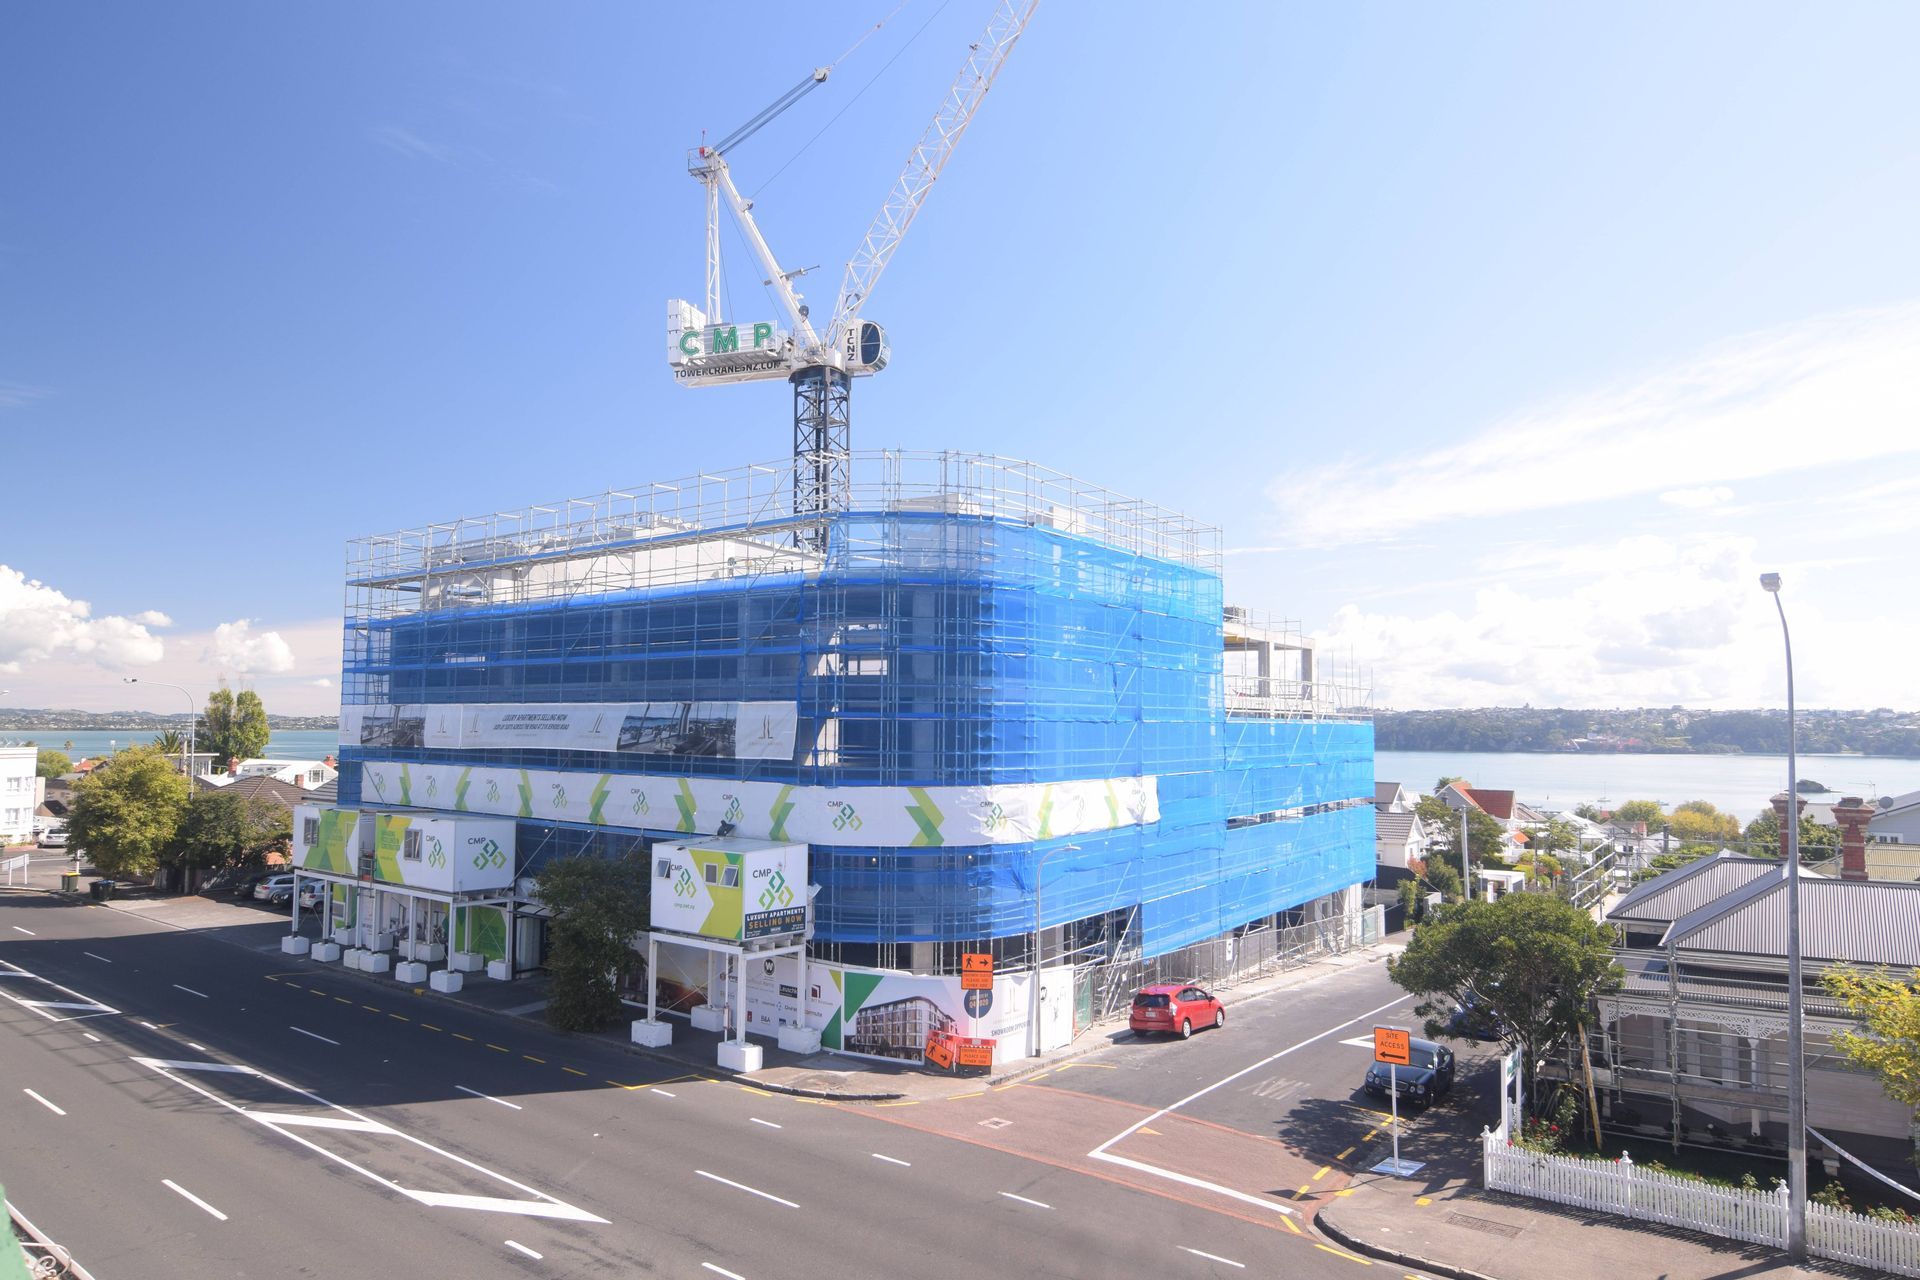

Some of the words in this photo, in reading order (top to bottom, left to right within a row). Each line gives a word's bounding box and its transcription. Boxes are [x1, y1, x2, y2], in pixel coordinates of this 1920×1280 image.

[679, 322, 774, 356] CMP
[467, 837, 487, 845] CMP
[752, 868, 772, 879] CMP
[746, 912, 769, 921] LUXURY
[770, 907, 805, 918] APARTMENTS
[748, 917, 783, 930] SELLING
[785, 914, 803, 924] NOW
[1380, 1041, 1405, 1050] ACCESS
